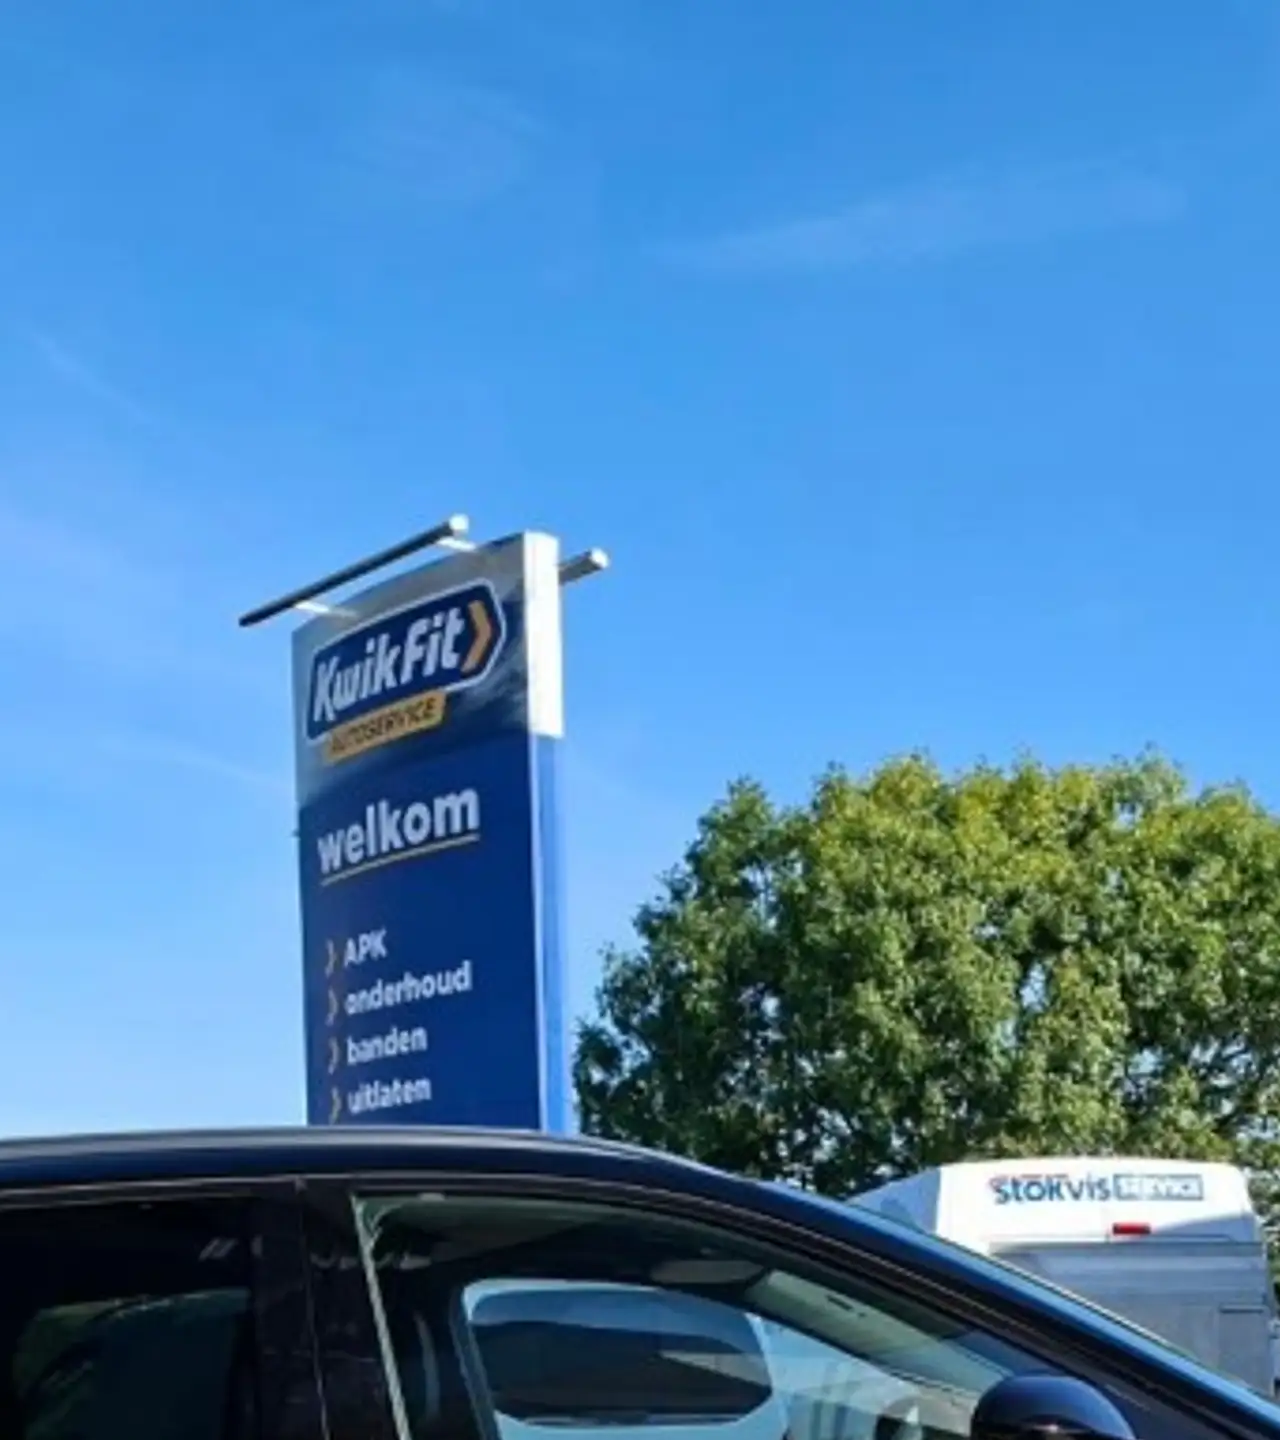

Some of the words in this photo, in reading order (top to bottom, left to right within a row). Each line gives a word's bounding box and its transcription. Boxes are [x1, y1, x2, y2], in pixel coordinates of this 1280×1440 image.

[317, 787, 480, 875] welkom
[343, 926, 387, 969] APK
[344, 959, 473, 1016] onderhoud
[346, 1026, 428, 1066] banden
[347, 1077, 433, 1115] uitlaten
